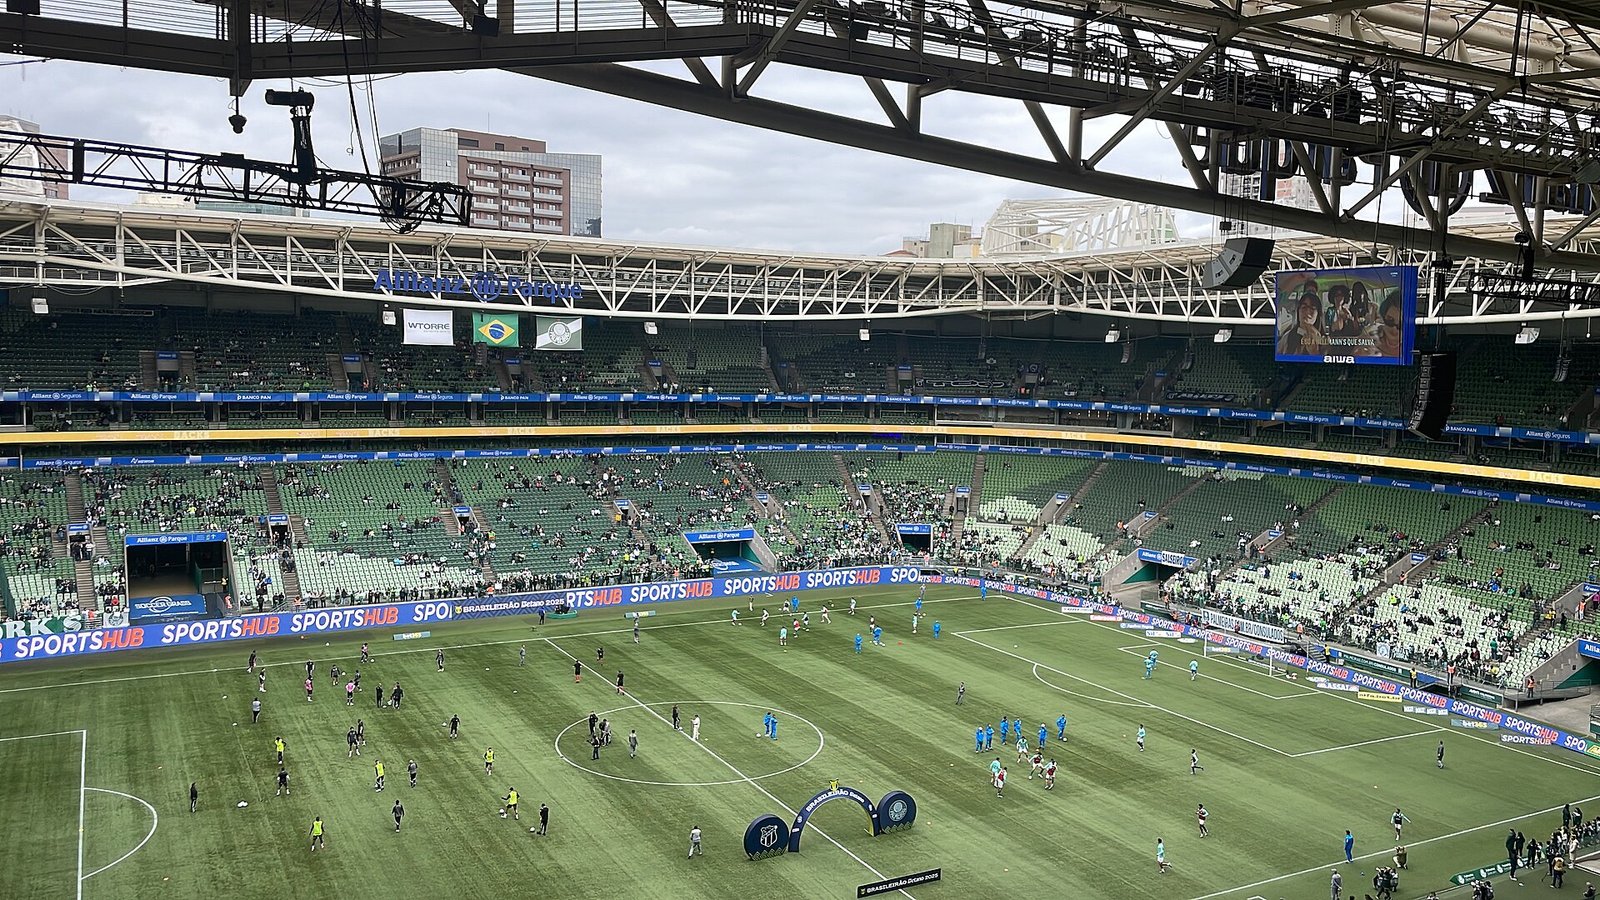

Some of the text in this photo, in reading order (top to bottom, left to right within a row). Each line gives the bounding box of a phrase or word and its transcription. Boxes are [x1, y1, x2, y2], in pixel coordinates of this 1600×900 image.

[374, 268, 584, 304] Allianz Parque
[408, 322, 450, 330] WTORRE
[1324, 356, 1354, 364] aiwa
[724, 532, 740, 540] Parque
[724, 575, 801, 595] SPORTSHUB
[807, 569, 880, 588] SPORTSHUB
[944, 576, 980, 586] SPORTSHUB
[984, 579, 1015, 593] SPORTSHUB
[630, 582, 713, 602] SPORTSHUB
[1017, 585, 1047, 598] SPORTSHUB
[1050, 592, 1080, 606] SPORTSHUB
[463, 602, 520, 613] BRASILEIRÃO
[546, 598, 564, 606] 2025
[1082, 600, 1113, 614] SPORTSHUB
[291, 606, 399, 632] SPORTSHUB
[1116, 608, 1150, 624] SPORTSHUB
[162, 616, 280, 644] SPORTSHUB
[1151, 618, 1184, 632] SPORTSHUB
[15, 628, 144, 658] SPORTSHUB
[1188, 627, 1224, 643] SPORTSHUB
[1225, 637, 1263, 654] SPORTSHUB
[1266, 648, 1306, 666] SPORTSHUB
[1307, 660, 1349, 680] SPORTSHUB
[1352, 673, 1396, 694] SPORTSHUB
[1399, 687, 1447, 708] SPORTSHUB
[1452, 700, 1502, 724] SPORTSHUB
[1504, 716, 1558, 742] SPORTSHUB
[1501, 735, 1552, 746] SPORTSHUB
[806, 788, 848, 812] BRASILEIRÃO
[866, 880, 906, 894] BRASILEIRÃO
